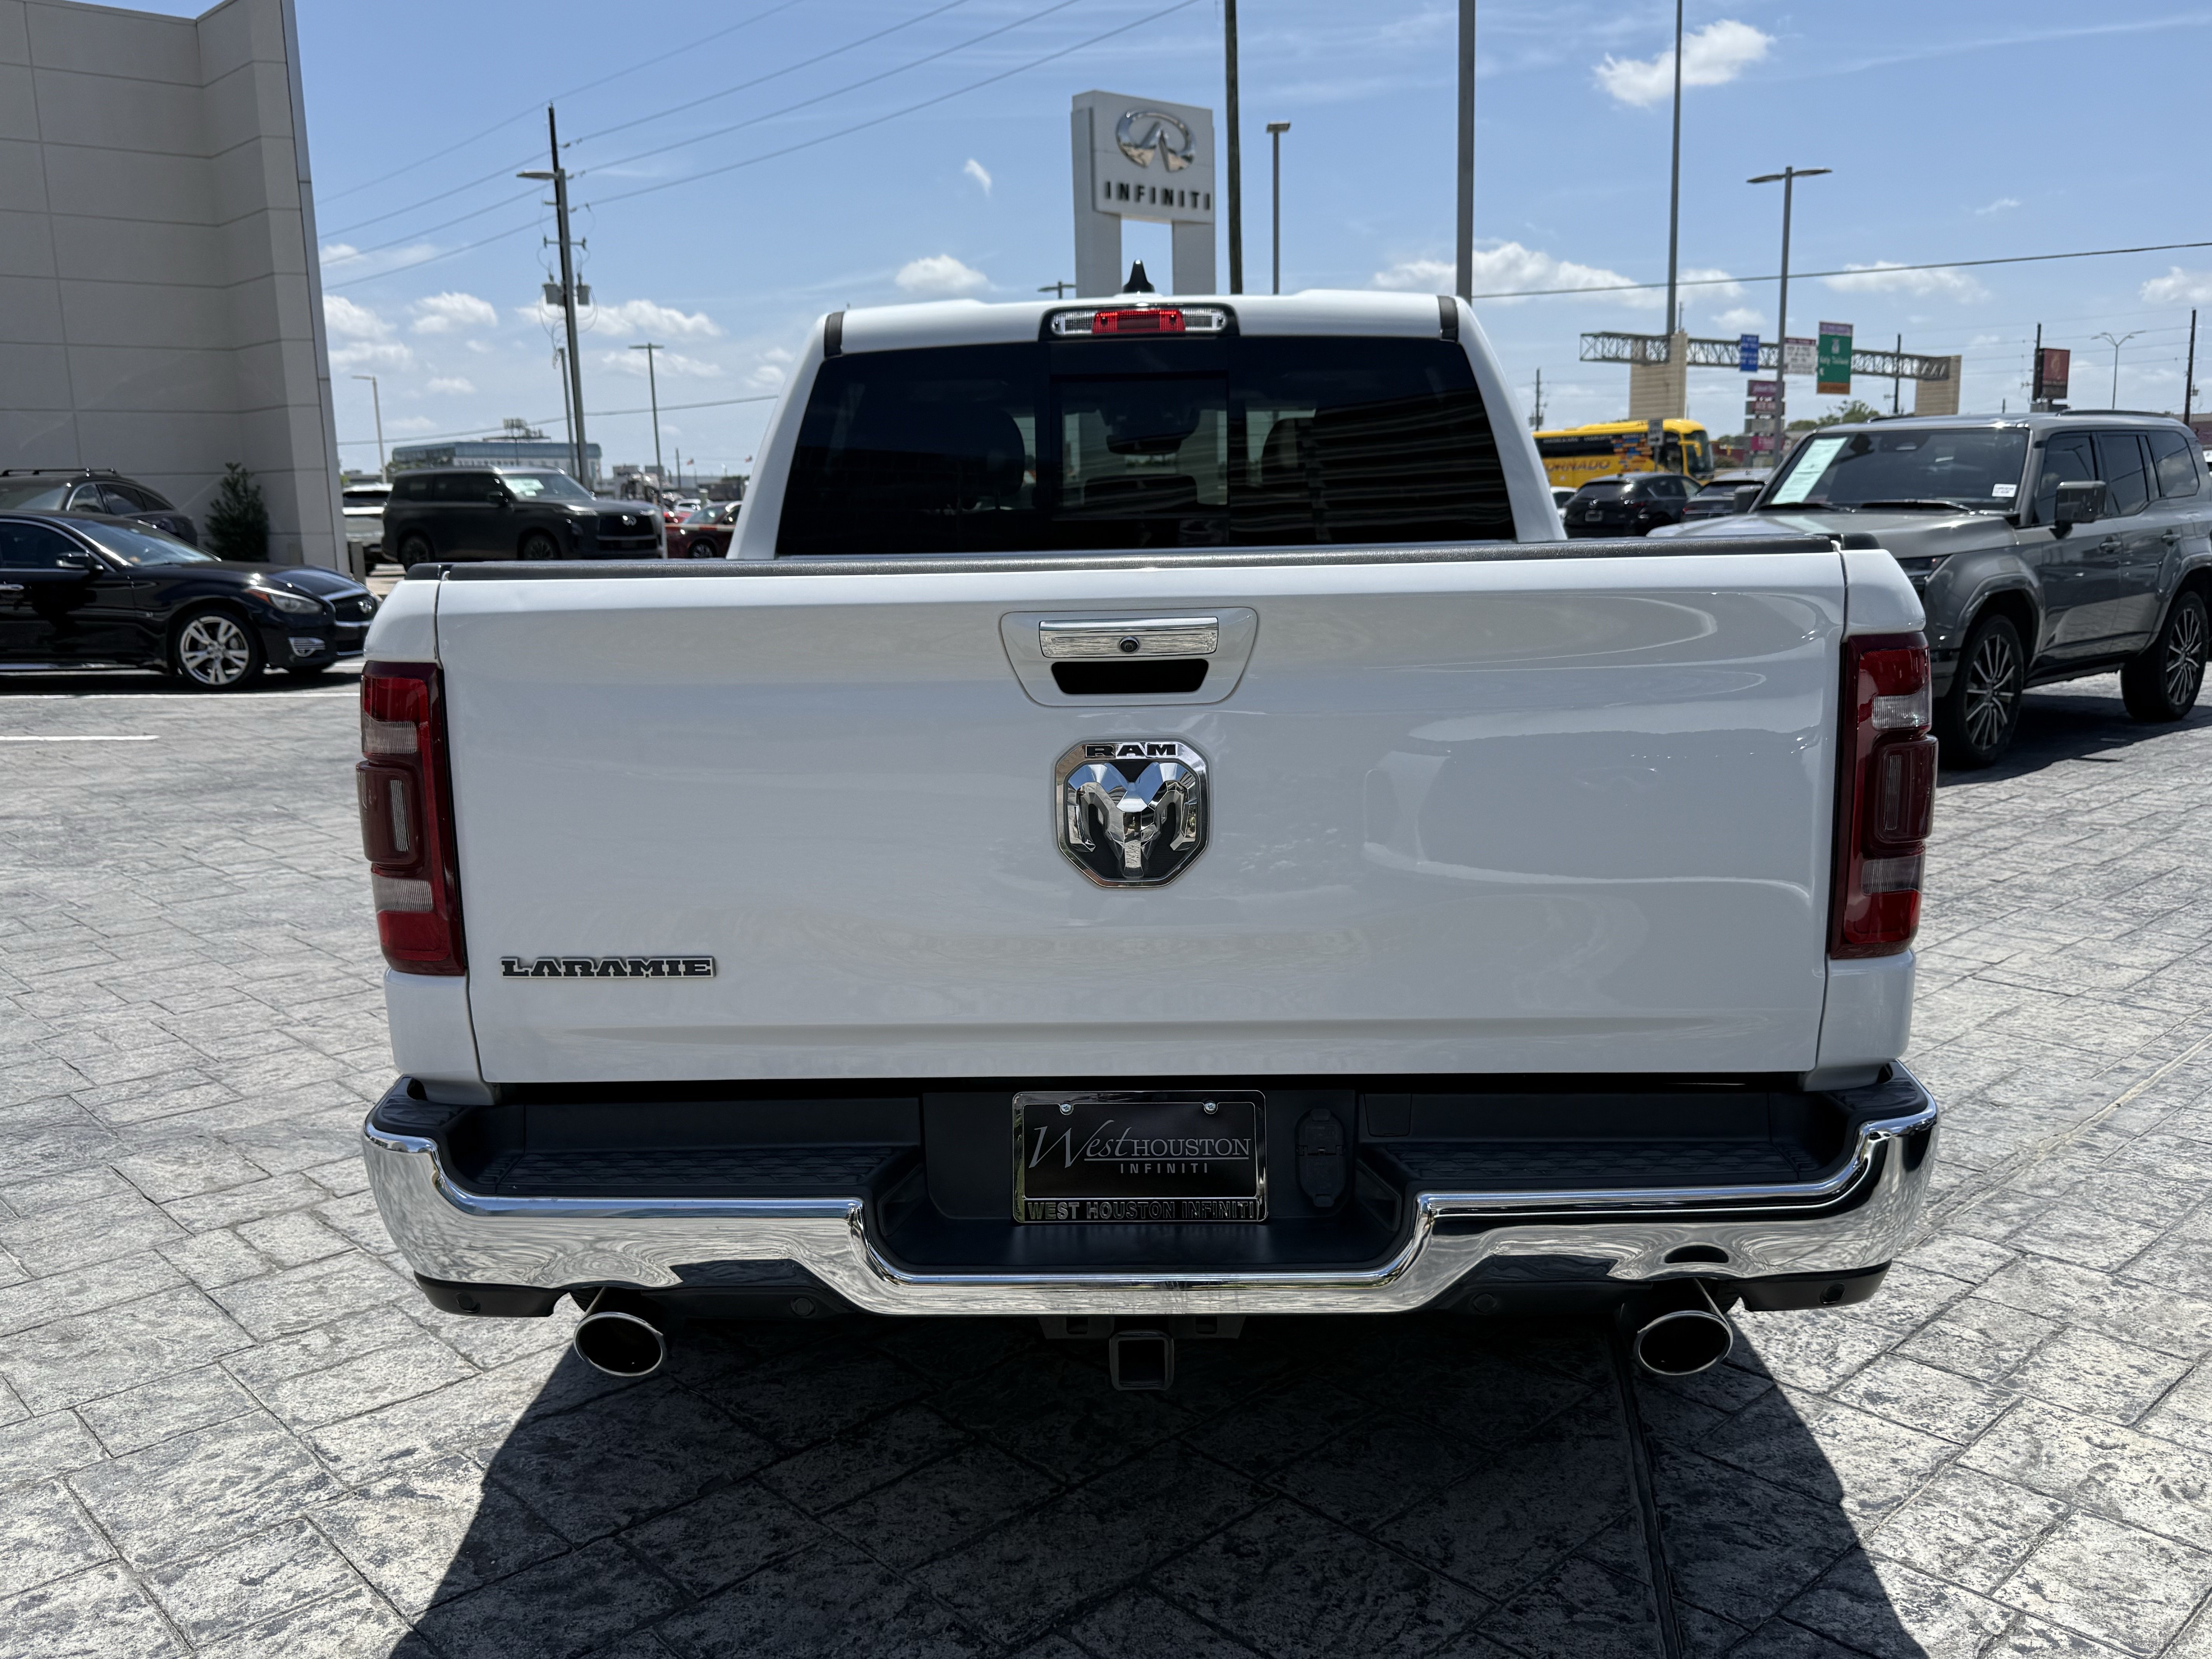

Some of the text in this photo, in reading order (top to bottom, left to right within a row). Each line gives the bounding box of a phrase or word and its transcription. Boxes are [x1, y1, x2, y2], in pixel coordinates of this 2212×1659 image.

[1104, 181, 1211, 210] INFINITI
[1085, 742, 1178, 758] RAM
[501, 956, 716, 978] LARAMIE
[1132, 1139, 1251, 1156] HOUSTON
[1121, 1163, 1208, 1174] INFINITI
[1027, 1201, 1254, 1220] WEST HOUSTON INFINITI
